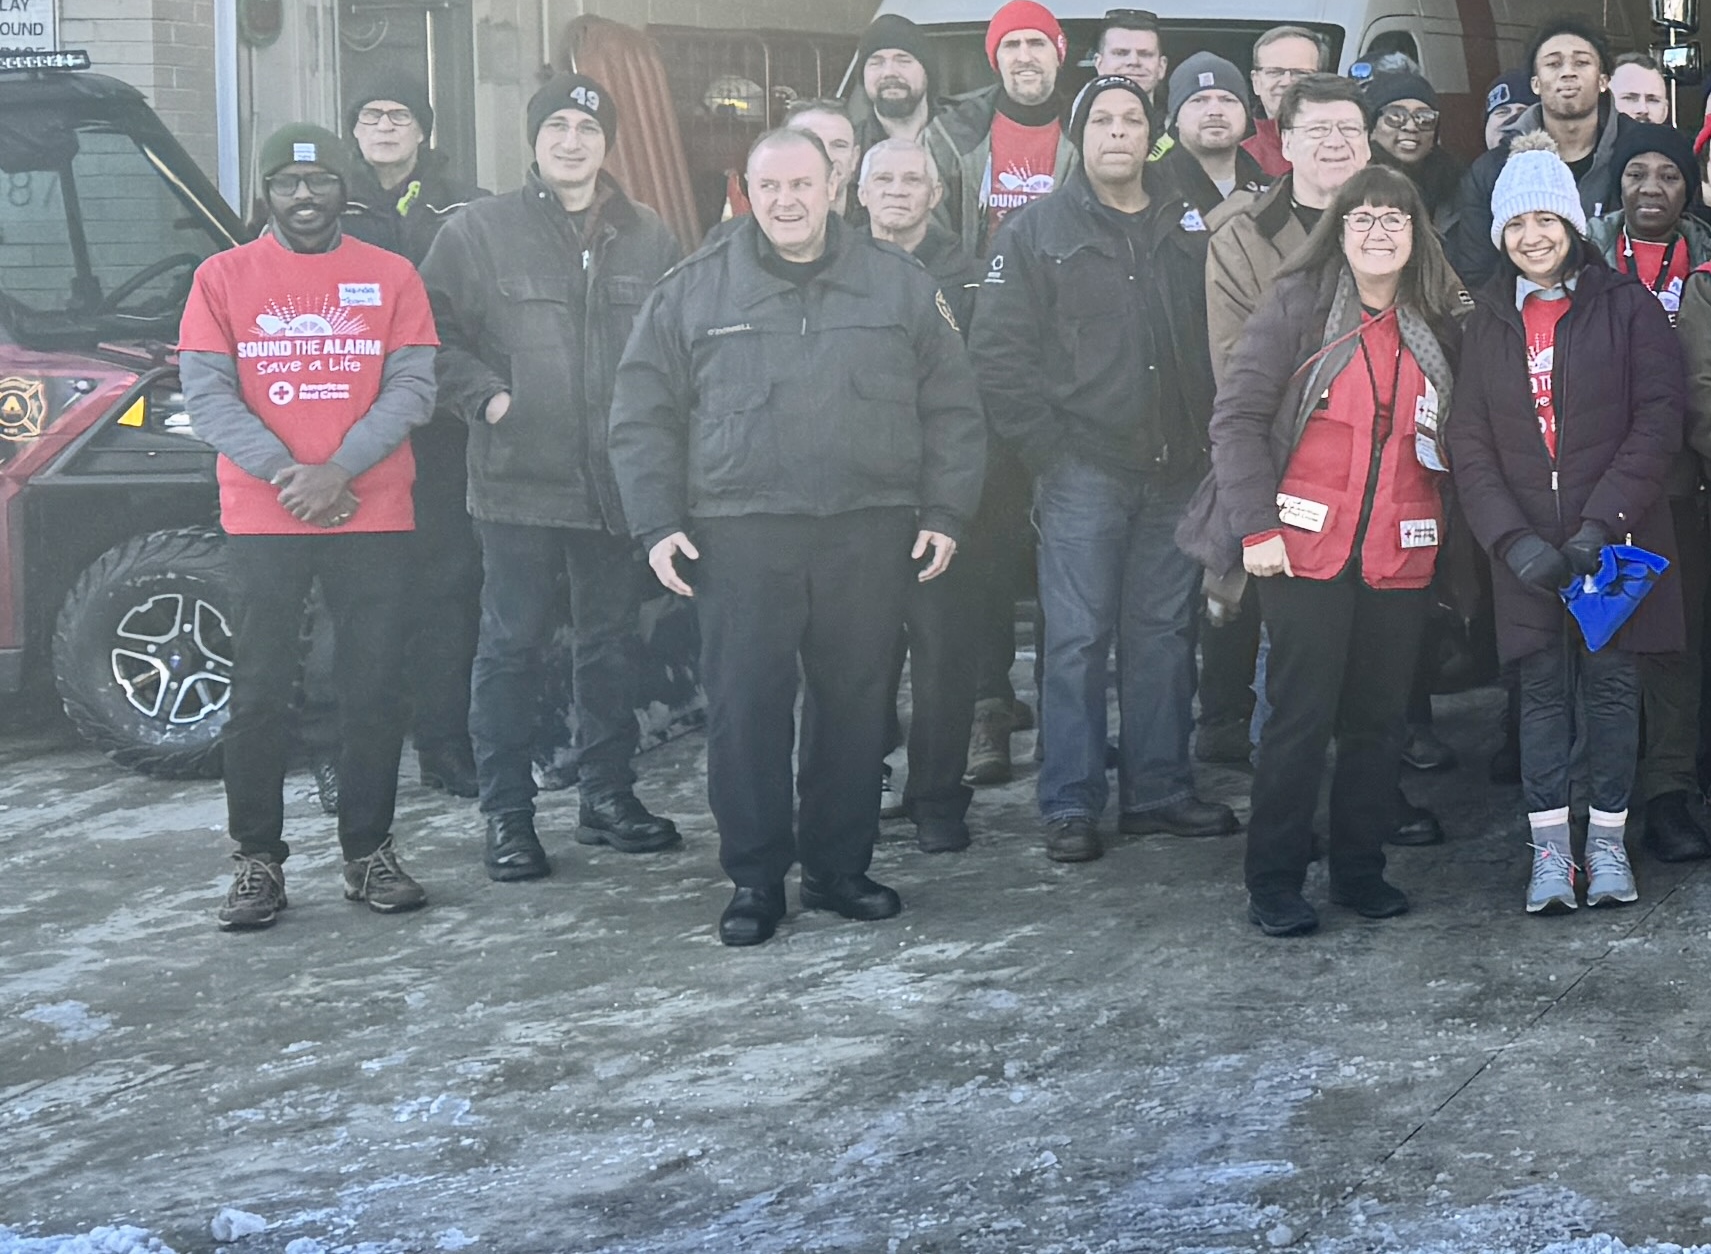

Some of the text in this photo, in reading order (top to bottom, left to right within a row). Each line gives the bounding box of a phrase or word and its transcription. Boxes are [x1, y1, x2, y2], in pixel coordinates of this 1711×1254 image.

[0, 22, 44, 36] OUND
[570, 86, 600, 111] 49
[989, 193, 1028, 208] OUND
[237, 338, 381, 358] SOUND THE ALARM
[256, 355, 361, 375] Save a Life
